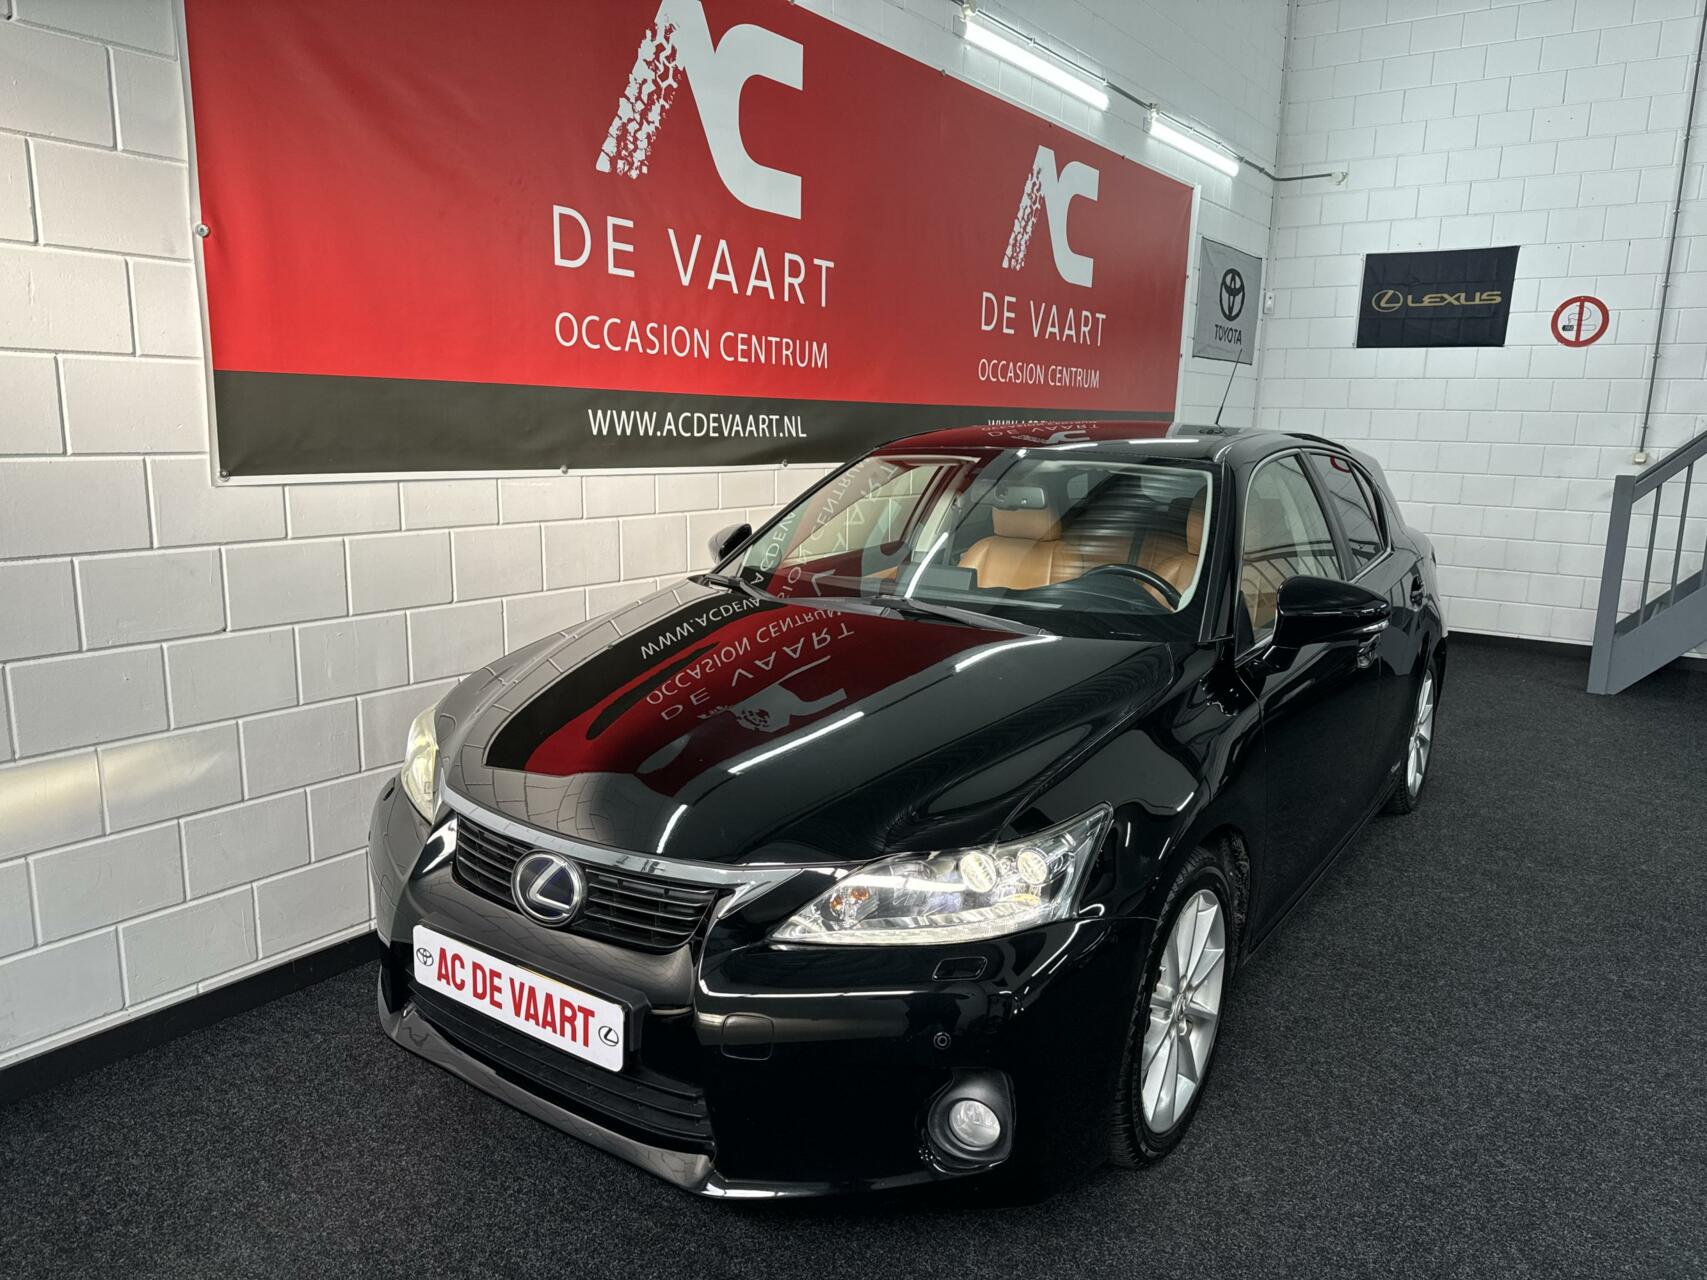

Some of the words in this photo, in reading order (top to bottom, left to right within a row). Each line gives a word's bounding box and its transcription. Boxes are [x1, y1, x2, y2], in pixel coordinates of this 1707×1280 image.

[553, 204, 635, 278] DE
[667, 228, 835, 307] VAART
[981, 291, 1016, 334] DE
[1030, 300, 1106, 347] VAART
[1407, 291, 1502, 307] LEXUS
[555, 312, 710, 359] OCCASION
[720, 331, 828, 369] CENTRUM
[1215, 324, 1242, 345] TOYOTA
[978, 358, 1045, 384] OCCASION
[1048, 365, 1100, 389] CENTRUM
[588, 408, 807, 438] WWW.ACDEVAART.NL
[437, 947, 465, 991] AC
[472, 961, 503, 1010] DE
[509, 977, 595, 1048] VAART
